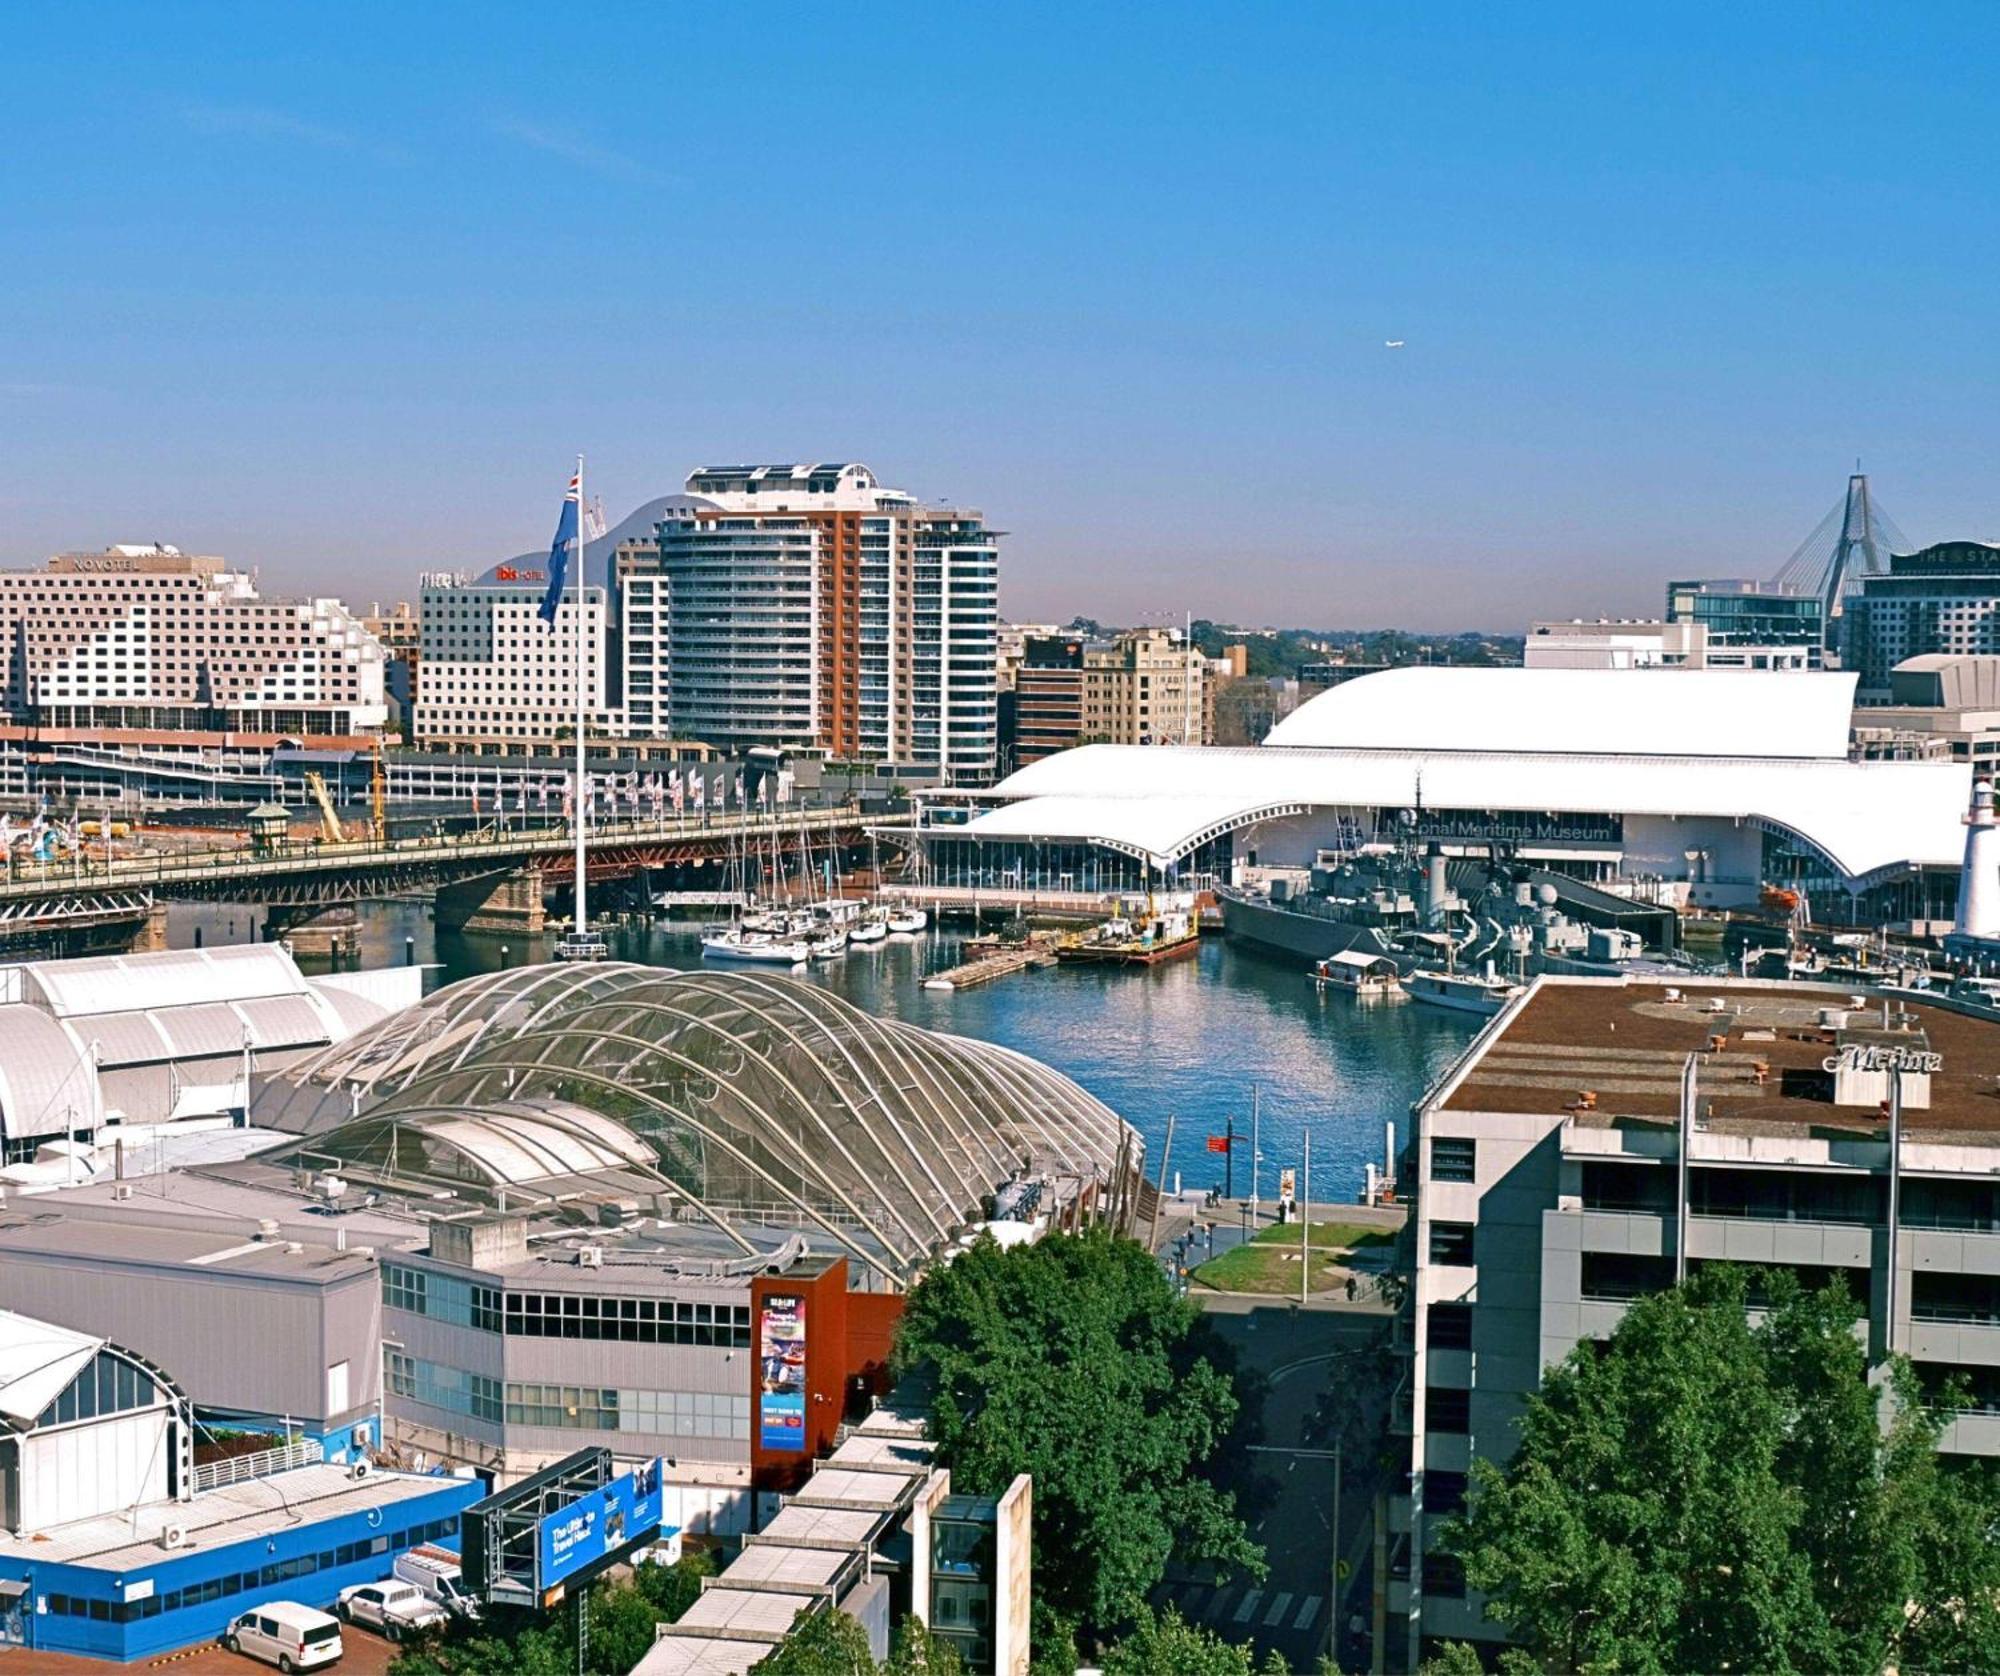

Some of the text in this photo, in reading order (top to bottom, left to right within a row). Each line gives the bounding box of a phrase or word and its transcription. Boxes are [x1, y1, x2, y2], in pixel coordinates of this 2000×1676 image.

[1920, 550, 1948, 562] THE
[74, 559, 141, 573] NOVOTEL
[496, 566, 519, 581] ibis
[1457, 821, 1533, 839] Maritime
[1537, 823, 1610, 840] Museum
